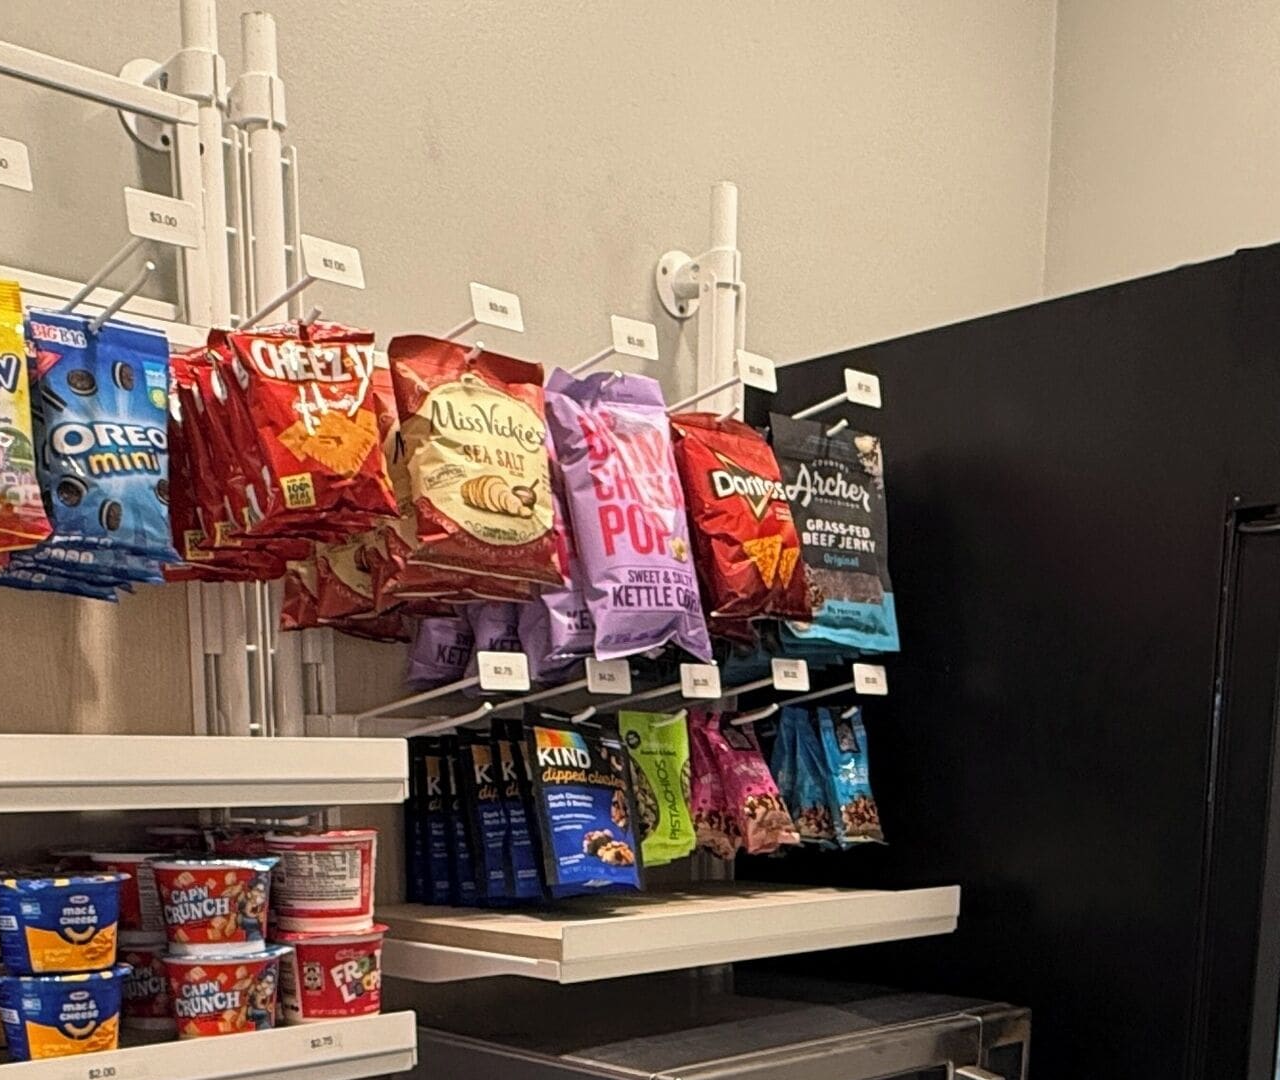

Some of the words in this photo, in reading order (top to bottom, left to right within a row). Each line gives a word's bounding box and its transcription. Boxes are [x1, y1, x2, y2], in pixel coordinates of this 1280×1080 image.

[31, 321, 58, 341] BIG
[430, 400, 483, 434] Miss
[472, 403, 548, 454] Vickie's
[52, 424, 167, 455] OREO
[88, 452, 159, 475] mini
[463, 444, 493, 465] SEA
[496, 448, 526, 471] SALT
[712, 471, 786, 499] Doritos
[785, 463, 871, 513] Archer
[806, 519, 871, 538] GRASS-FED
[802, 532, 836, 546] BEEF
[838, 536, 876, 553] JERKY
[823, 552, 860, 568] Original
[627, 570, 661, 584] SWEET
[662, 571, 671, 584] &
[612, 585, 673, 607] KETTLE
[536, 747, 591, 769] KIND
[542, 767, 587, 785] dipped
[655, 759, 680, 840] PISTACHIOS
[62, 907, 87, 916] mac
[165, 898, 230, 925] CRUNCH
[62, 1003, 88, 1012] mac
[176, 991, 240, 1018] CRUNCH
[89, 1066, 115, 1080] $2.00
